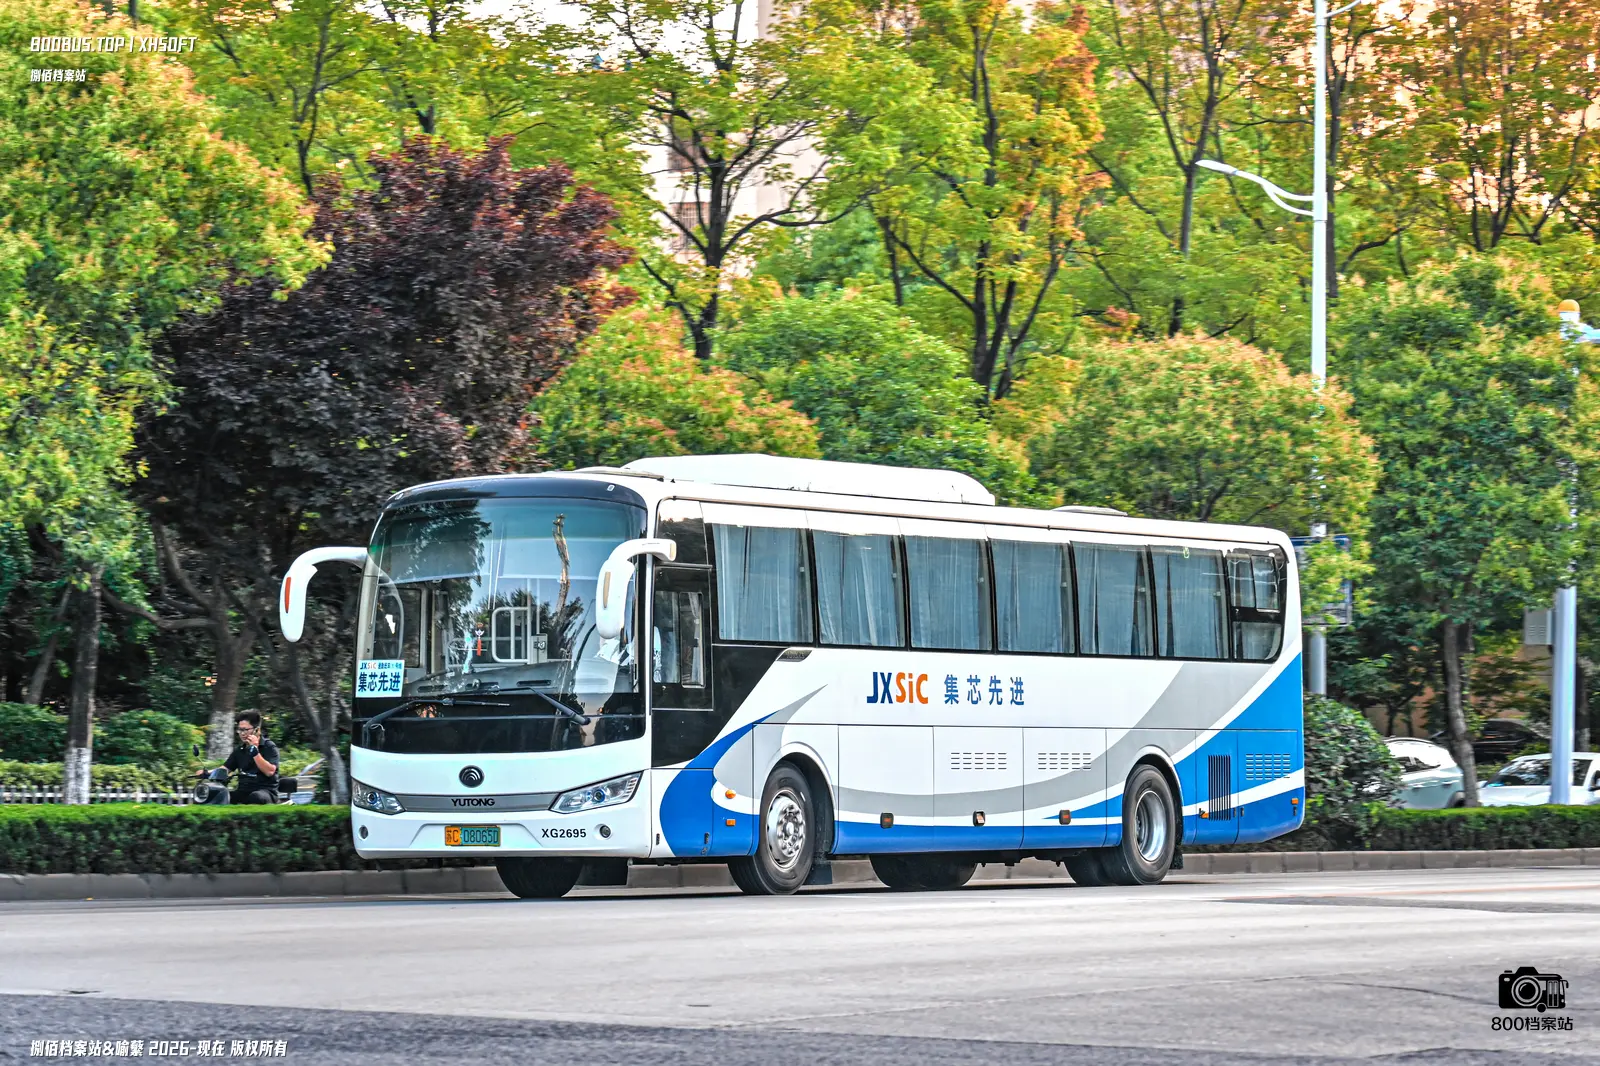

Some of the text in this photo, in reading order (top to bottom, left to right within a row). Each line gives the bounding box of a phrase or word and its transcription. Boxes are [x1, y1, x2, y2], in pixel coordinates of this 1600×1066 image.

[360, 662, 376, 670] JXSiC
[358, 671, 401, 692] 集芯先进
[866, 671, 929, 705] JXSiC
[943, 674, 1025, 706] 集芯先进
[451, 798, 496, 807] YUTONG
[541, 828, 587, 839] XG2695
